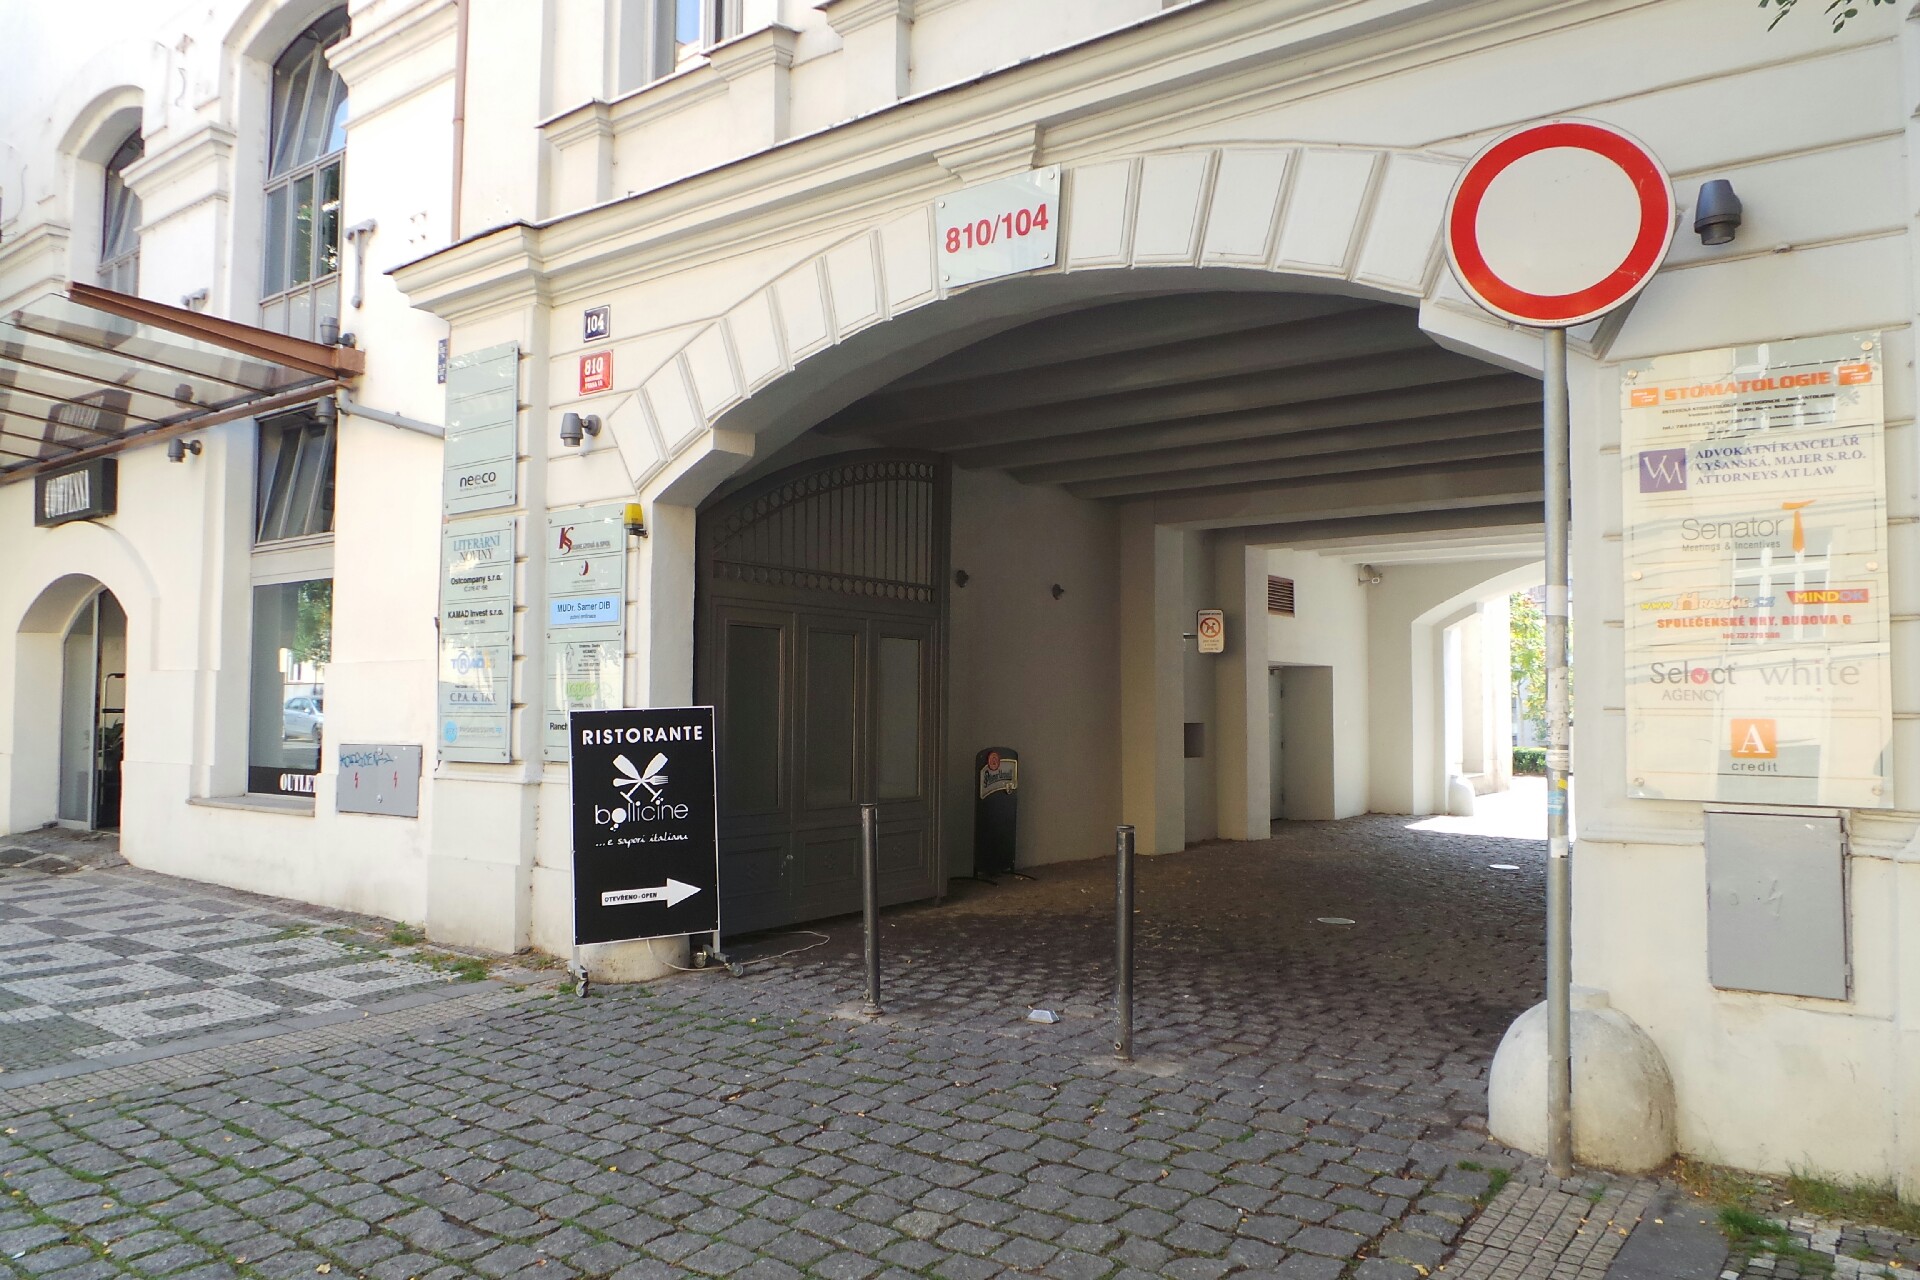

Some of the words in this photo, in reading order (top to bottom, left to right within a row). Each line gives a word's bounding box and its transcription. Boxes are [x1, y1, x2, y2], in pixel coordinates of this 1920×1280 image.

[945, 203, 1049, 254] 810/104
[587, 313, 604, 333] 104
[584, 357, 604, 376] 810
[1664, 374, 1831, 401] STOMATOLOGIE
[1696, 441, 1777, 460] ADVOKÁTNÍ
[1780, 434, 1860, 453] KANCELÁŘ
[1696, 456, 1771, 472] VYŠANSKÁ,
[1775, 453, 1822, 466] MAJER
[1826, 449, 1866, 462] S.R.O.
[460, 471, 496, 488] neeco
[1696, 470, 1778, 485] ATTORNEYS
[1782, 468, 1800, 480] AT
[1803, 465, 1836, 477] LAW
[1681, 516, 1784, 541] Senator
[1682, 543, 1721, 552] Meetings
[1725, 542, 1731, 550] &
[1735, 540, 1781, 550] Incentives
[450, 576, 486, 585] Ostcompany
[447, 610, 469, 619] KAMAD
[470, 609, 488, 617] Invest
[557, 605, 575, 613] MUDr.
[577, 602, 597, 610] Samer
[599, 601, 611, 610] DIB
[1657, 616, 1745, 629] SPOLEČENSKÉ
[1782, 616, 1838, 626] BUDOVA
[1760, 658, 1860, 692] white
[1662, 689, 1723, 702] AGENCY
[582, 726, 703, 745] RISTORANTE
[1737, 724, 1771, 754] A
[1731, 761, 1777, 772] credit
[595, 799, 689, 825] bollicine
[604, 894, 637, 902] OTEVŘENO
